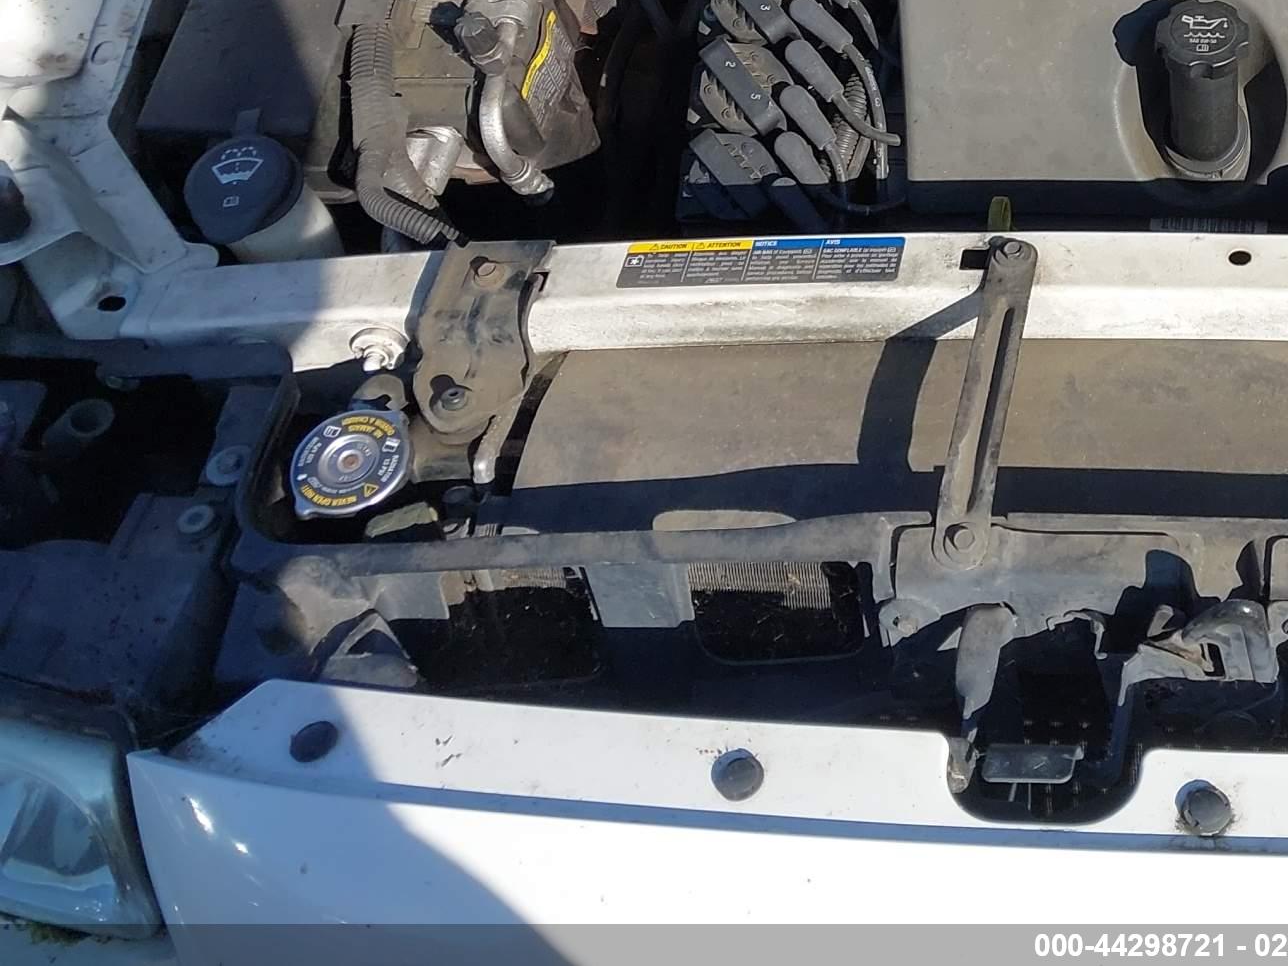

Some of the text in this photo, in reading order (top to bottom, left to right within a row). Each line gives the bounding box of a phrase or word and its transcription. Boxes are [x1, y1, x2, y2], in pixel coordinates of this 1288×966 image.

[759, 3, 771, 12] 3
[725, 60, 736, 69] 2
[749, 92, 762, 101] 5
[660, 242, 688, 250] CAUTION
[706, 242, 742, 250] ATTENTION
